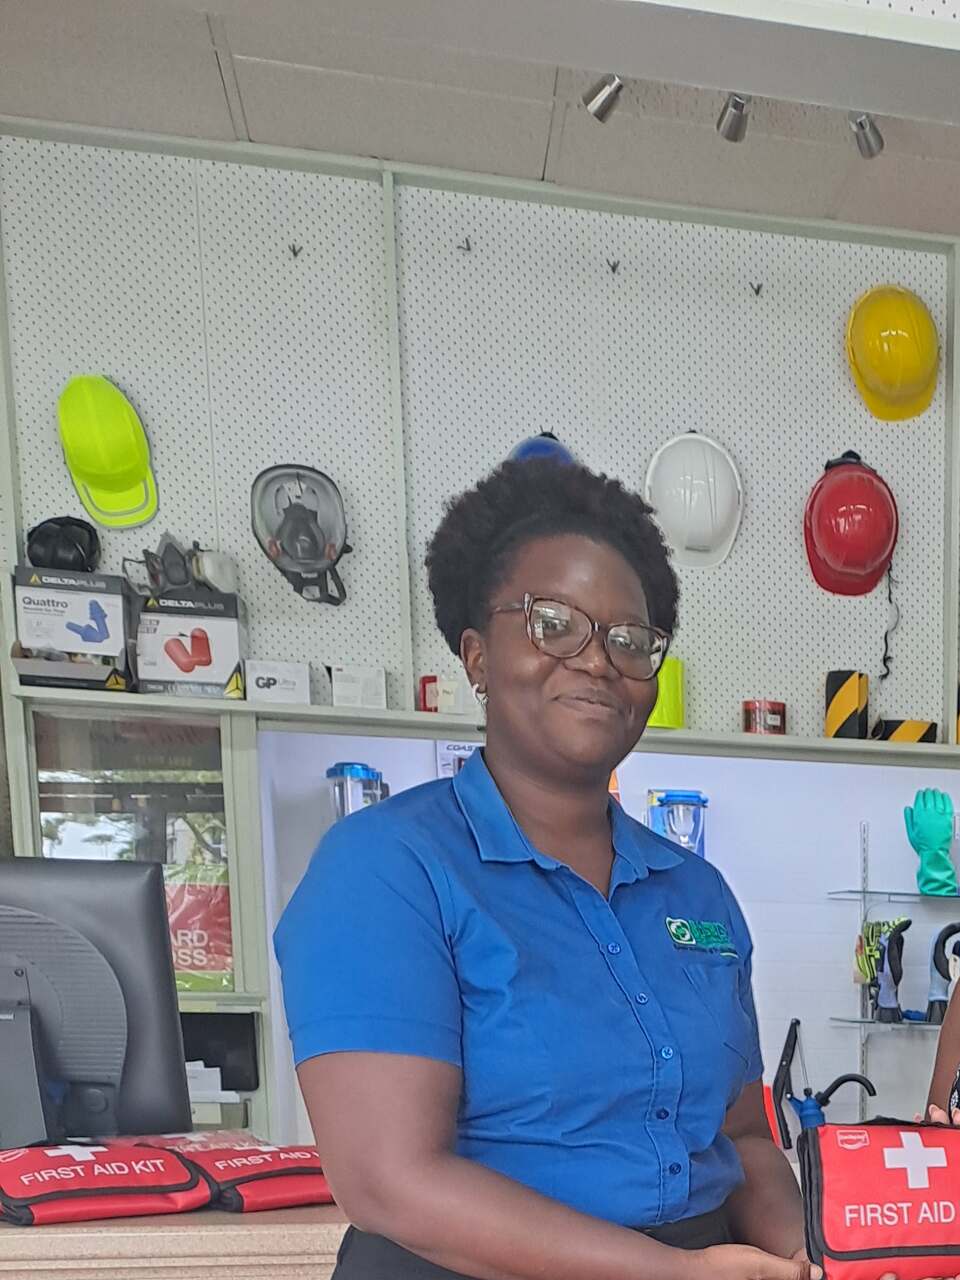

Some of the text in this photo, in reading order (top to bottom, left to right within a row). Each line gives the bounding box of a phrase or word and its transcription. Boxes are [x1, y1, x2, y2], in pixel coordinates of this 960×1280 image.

[22, 595, 69, 609] Quattro
[159, 598, 225, 611] DELTAPLUS
[255, 675, 278, 689] GP
[214, 1153, 274, 1171] FIRST
[279, 1149, 311, 1161] AID
[20, 1158, 166, 1186] FIRST AID KIT
[844, 1202, 912, 1227] FIRST
[917, 1201, 956, 1225] AID
